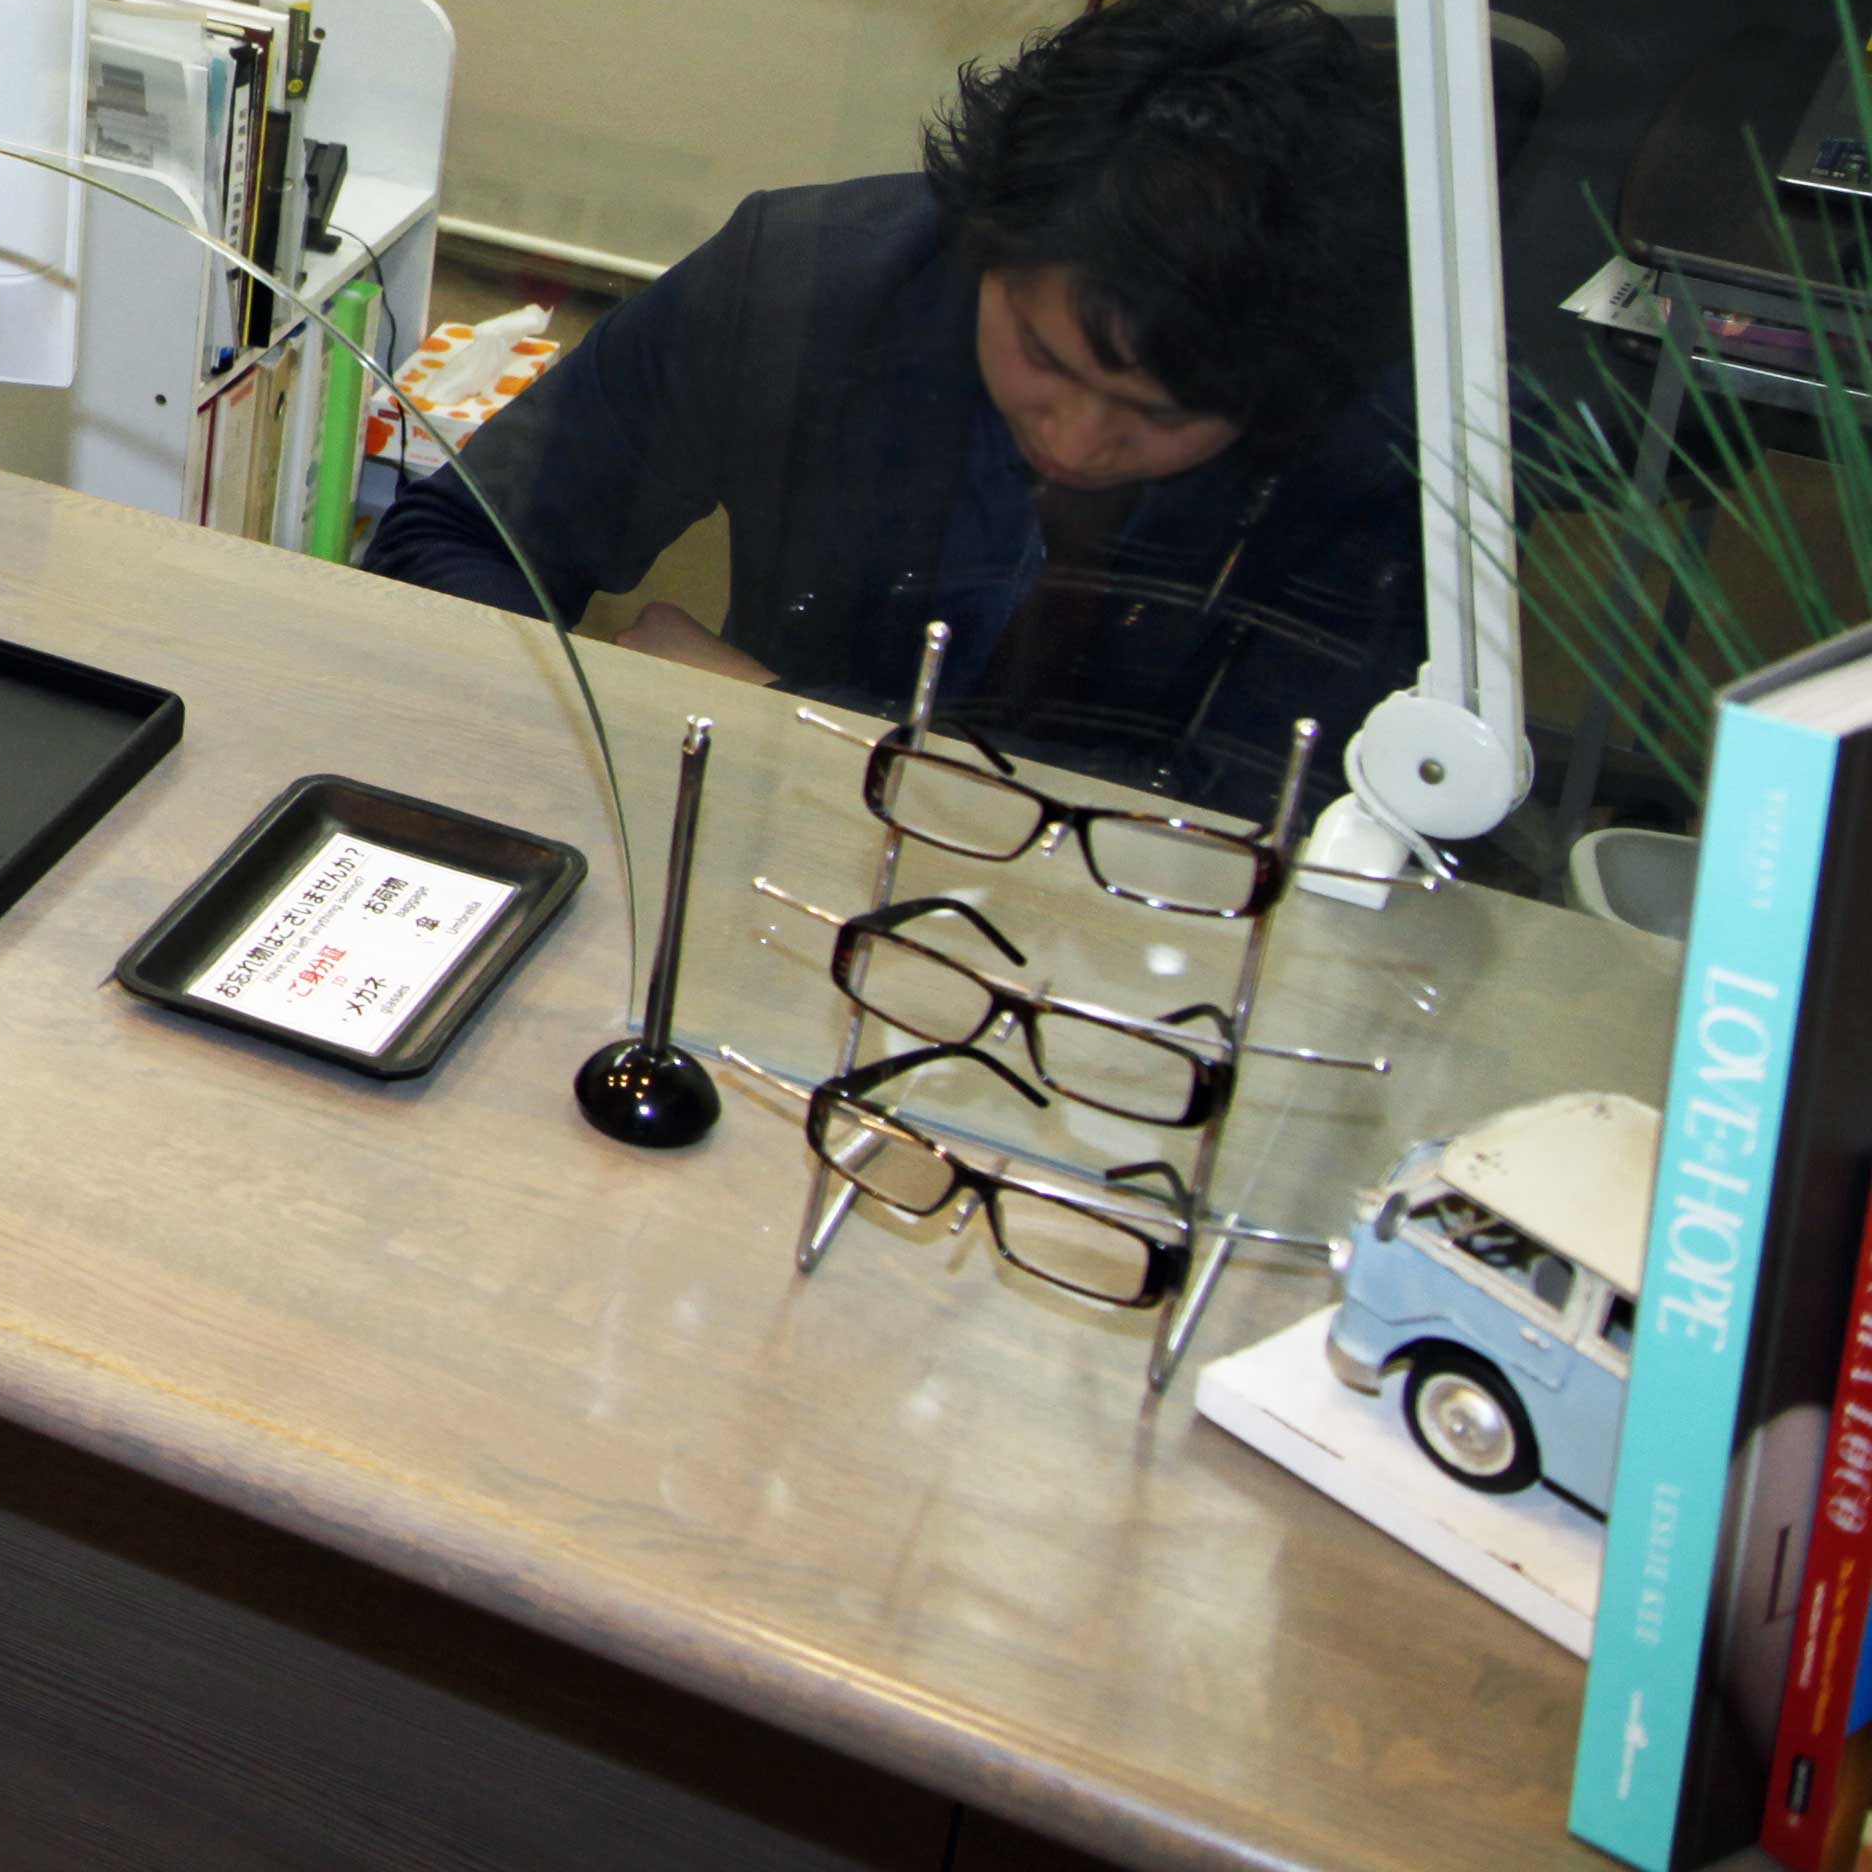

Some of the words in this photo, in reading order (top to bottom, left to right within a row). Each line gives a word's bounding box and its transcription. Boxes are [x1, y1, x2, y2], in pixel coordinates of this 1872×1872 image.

[364, 876, 409, 915] お荷物
[288, 945, 347, 998] ご身分証
[346, 975, 388, 1016] メガネ
